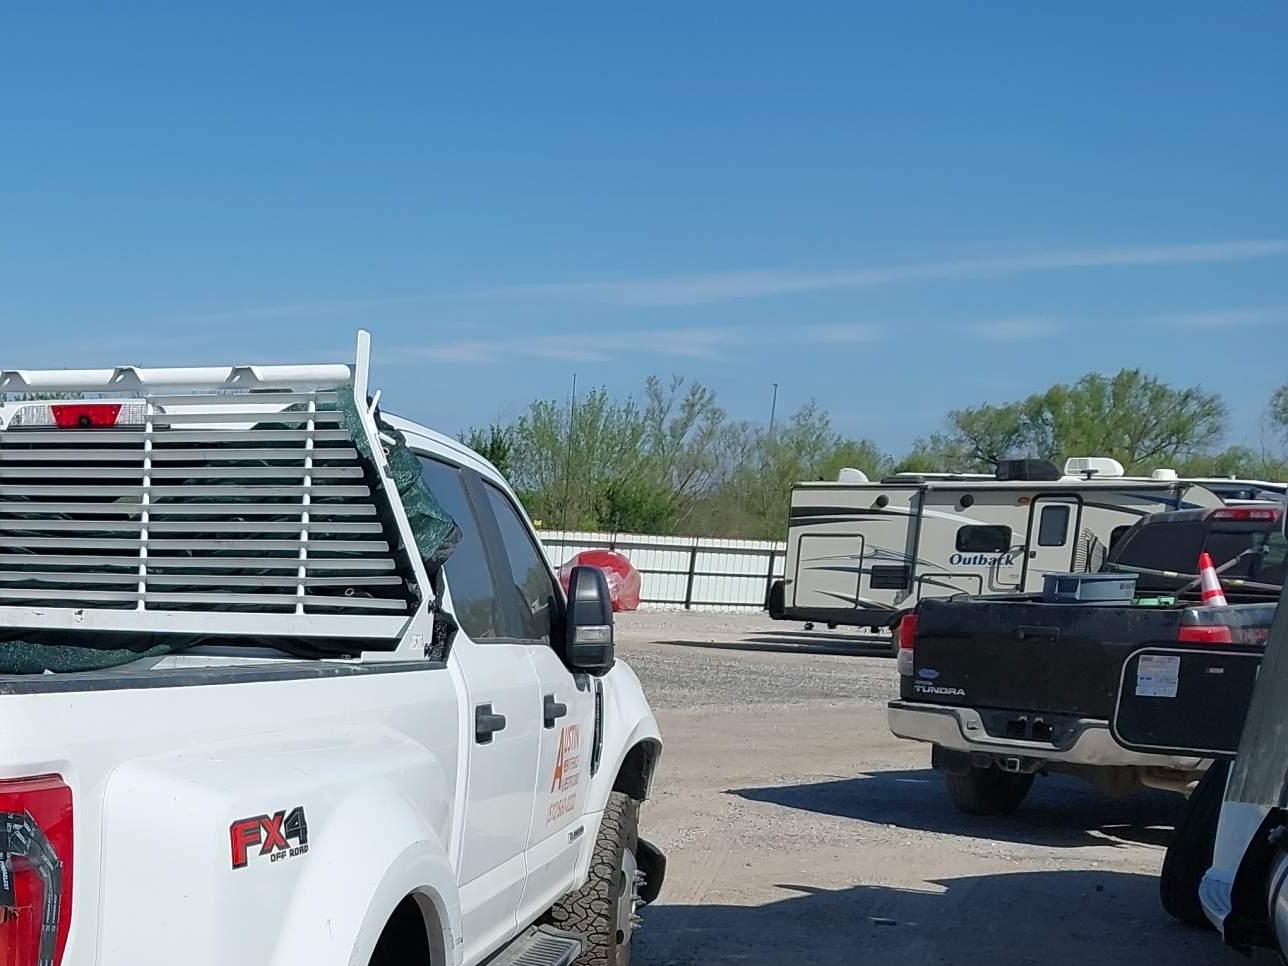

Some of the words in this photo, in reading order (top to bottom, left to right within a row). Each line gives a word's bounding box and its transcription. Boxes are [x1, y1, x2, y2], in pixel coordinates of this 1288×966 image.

[950, 553, 1014, 566] Outback
[914, 685, 966, 696] TUNDRA
[229, 806, 308, 870] FX4
[270, 850, 287, 863] OFF
[289, 845, 309, 858] ROAD
[0, 860, 10, 891] PROSELECT
